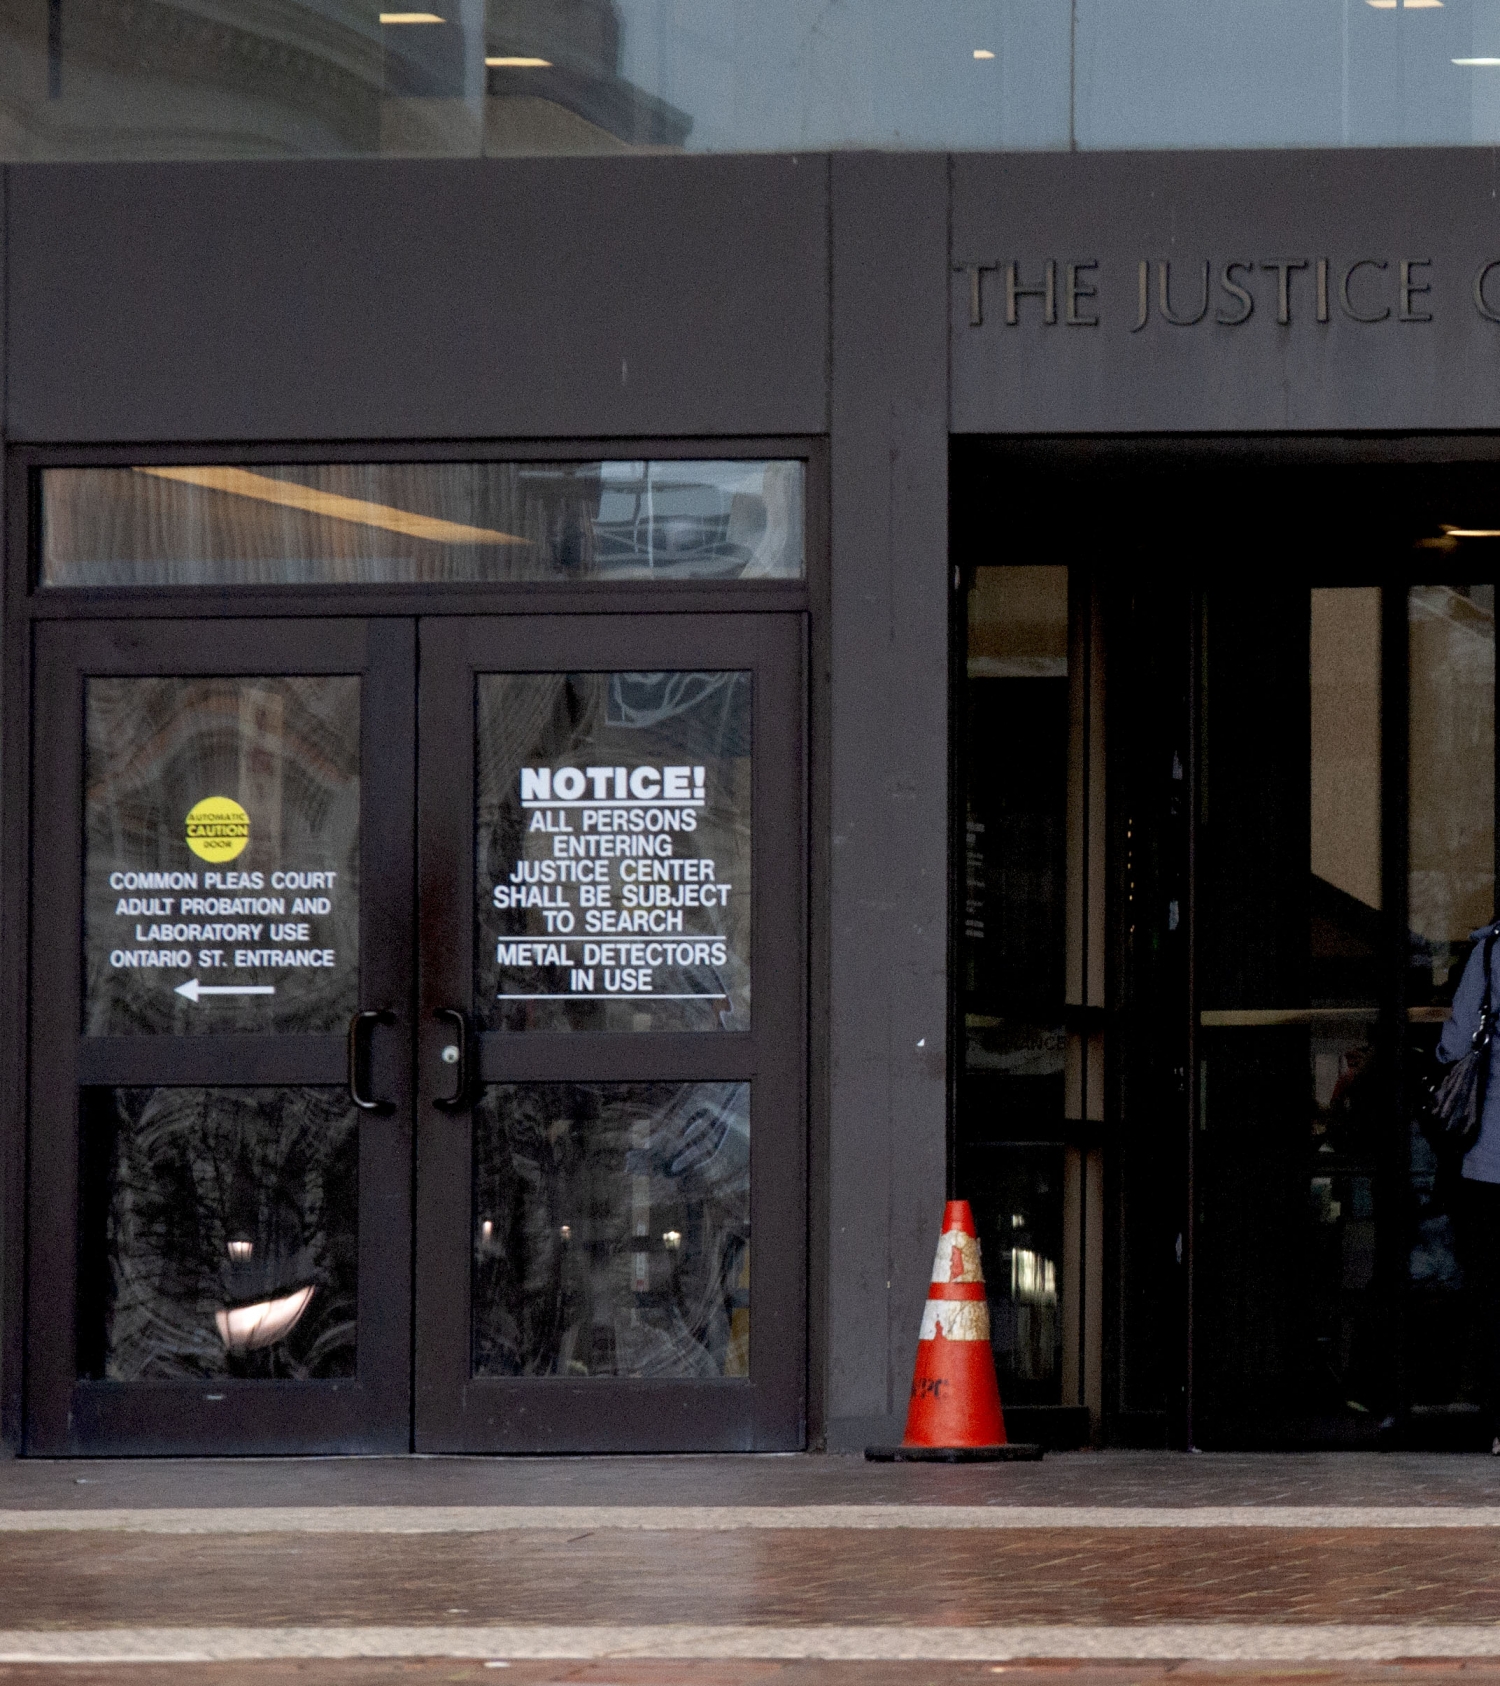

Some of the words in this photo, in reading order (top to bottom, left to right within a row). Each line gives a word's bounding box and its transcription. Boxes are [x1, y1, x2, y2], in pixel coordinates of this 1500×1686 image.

[953, 258, 1100, 328] THE
[1129, 256, 1434, 333] JUSTICE
[522, 766, 705, 799] NOTICE!
[187, 824, 248, 837] CAUTION
[530, 811, 573, 832] ALL
[583, 809, 696, 831] PERSONS
[554, 834, 672, 857] ENTERING
[110, 872, 197, 890] COMMON
[205, 872, 264, 889] PLEAS
[272, 872, 336, 889] COURT
[511, 860, 609, 882] JUSTICE
[620, 859, 715, 882] CENTER
[116, 898, 174, 915] ADULT
[182, 898, 284, 915] PROBATION
[292, 898, 331, 914] AND
[494, 886, 570, 908] SHALL
[580, 885, 611, 907] BE
[622, 884, 731, 907] SUBJECT
[543, 910, 574, 932] TO
[585, 910, 682, 932] SEARCH
[136, 924, 262, 941] LABORATORY
[271, 924, 309, 941] USE
[111, 950, 191, 967] ONTARIO
[199, 950, 227, 967] ST.
[235, 950, 334, 967] ENTRANCE
[498, 944, 574, 965] METAL
[585, 943, 726, 966] DETECTORS
[572, 969, 593, 990] IN
[605, 969, 652, 991] USE
